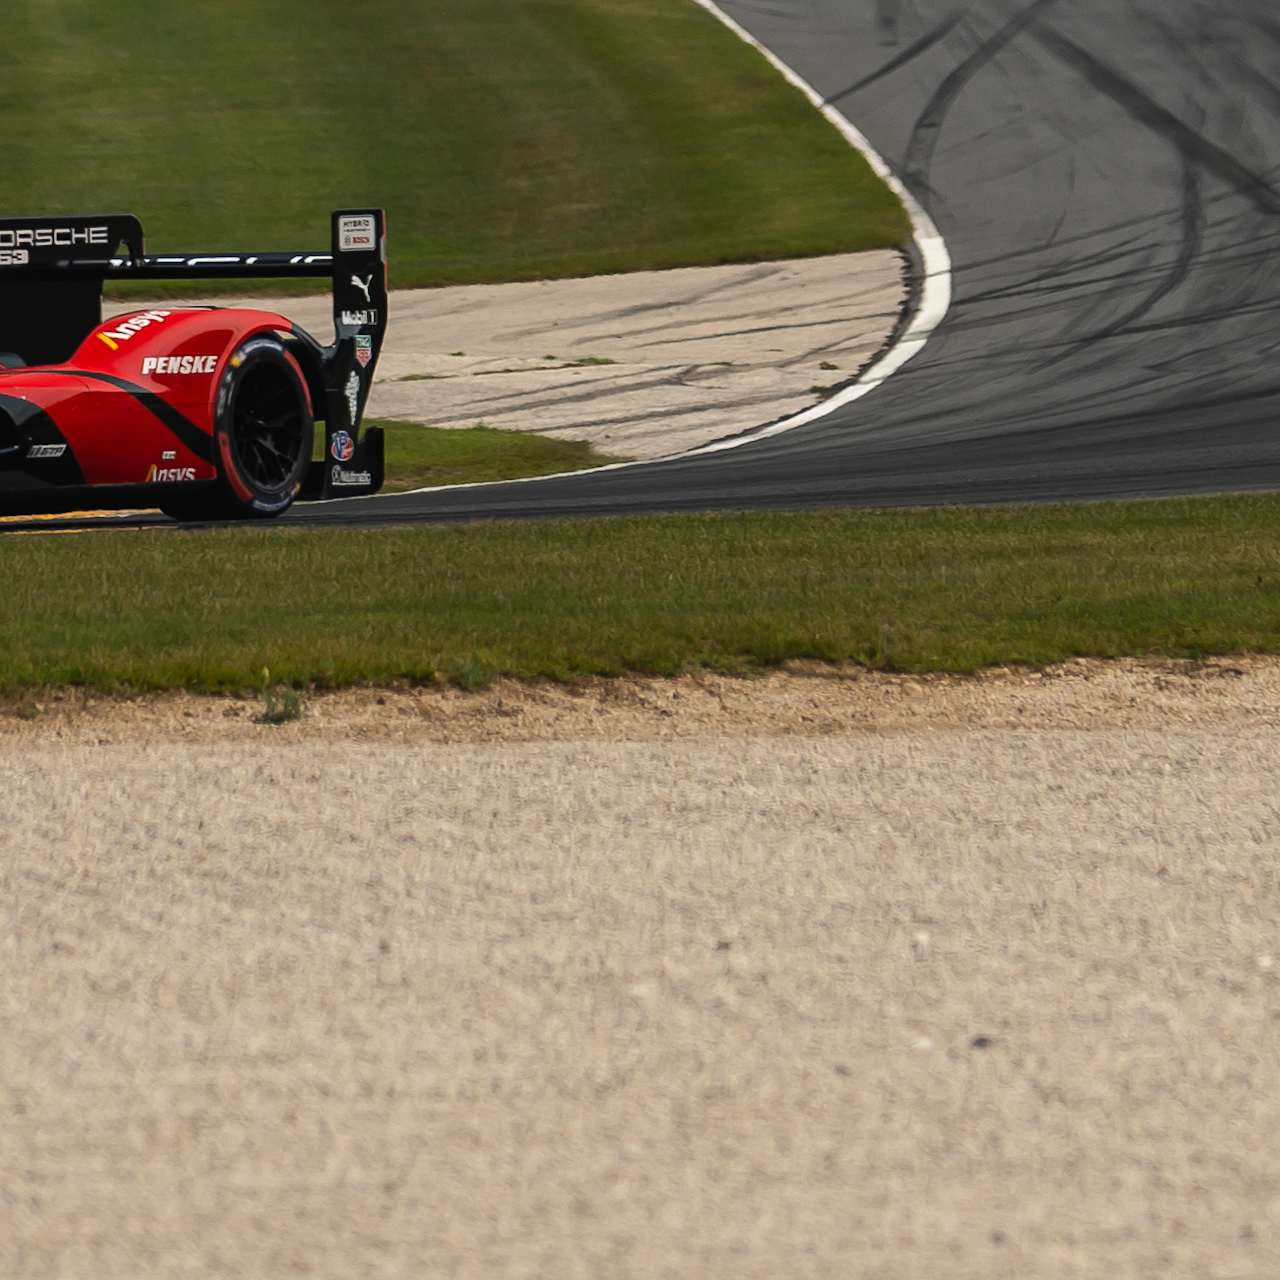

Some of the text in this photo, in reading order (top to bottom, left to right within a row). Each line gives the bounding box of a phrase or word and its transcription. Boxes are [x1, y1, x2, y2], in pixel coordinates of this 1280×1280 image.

[342, 310, 368, 325] Mobil
[96, 310, 172, 351] Ansys
[141, 355, 218, 375] PENSKE
